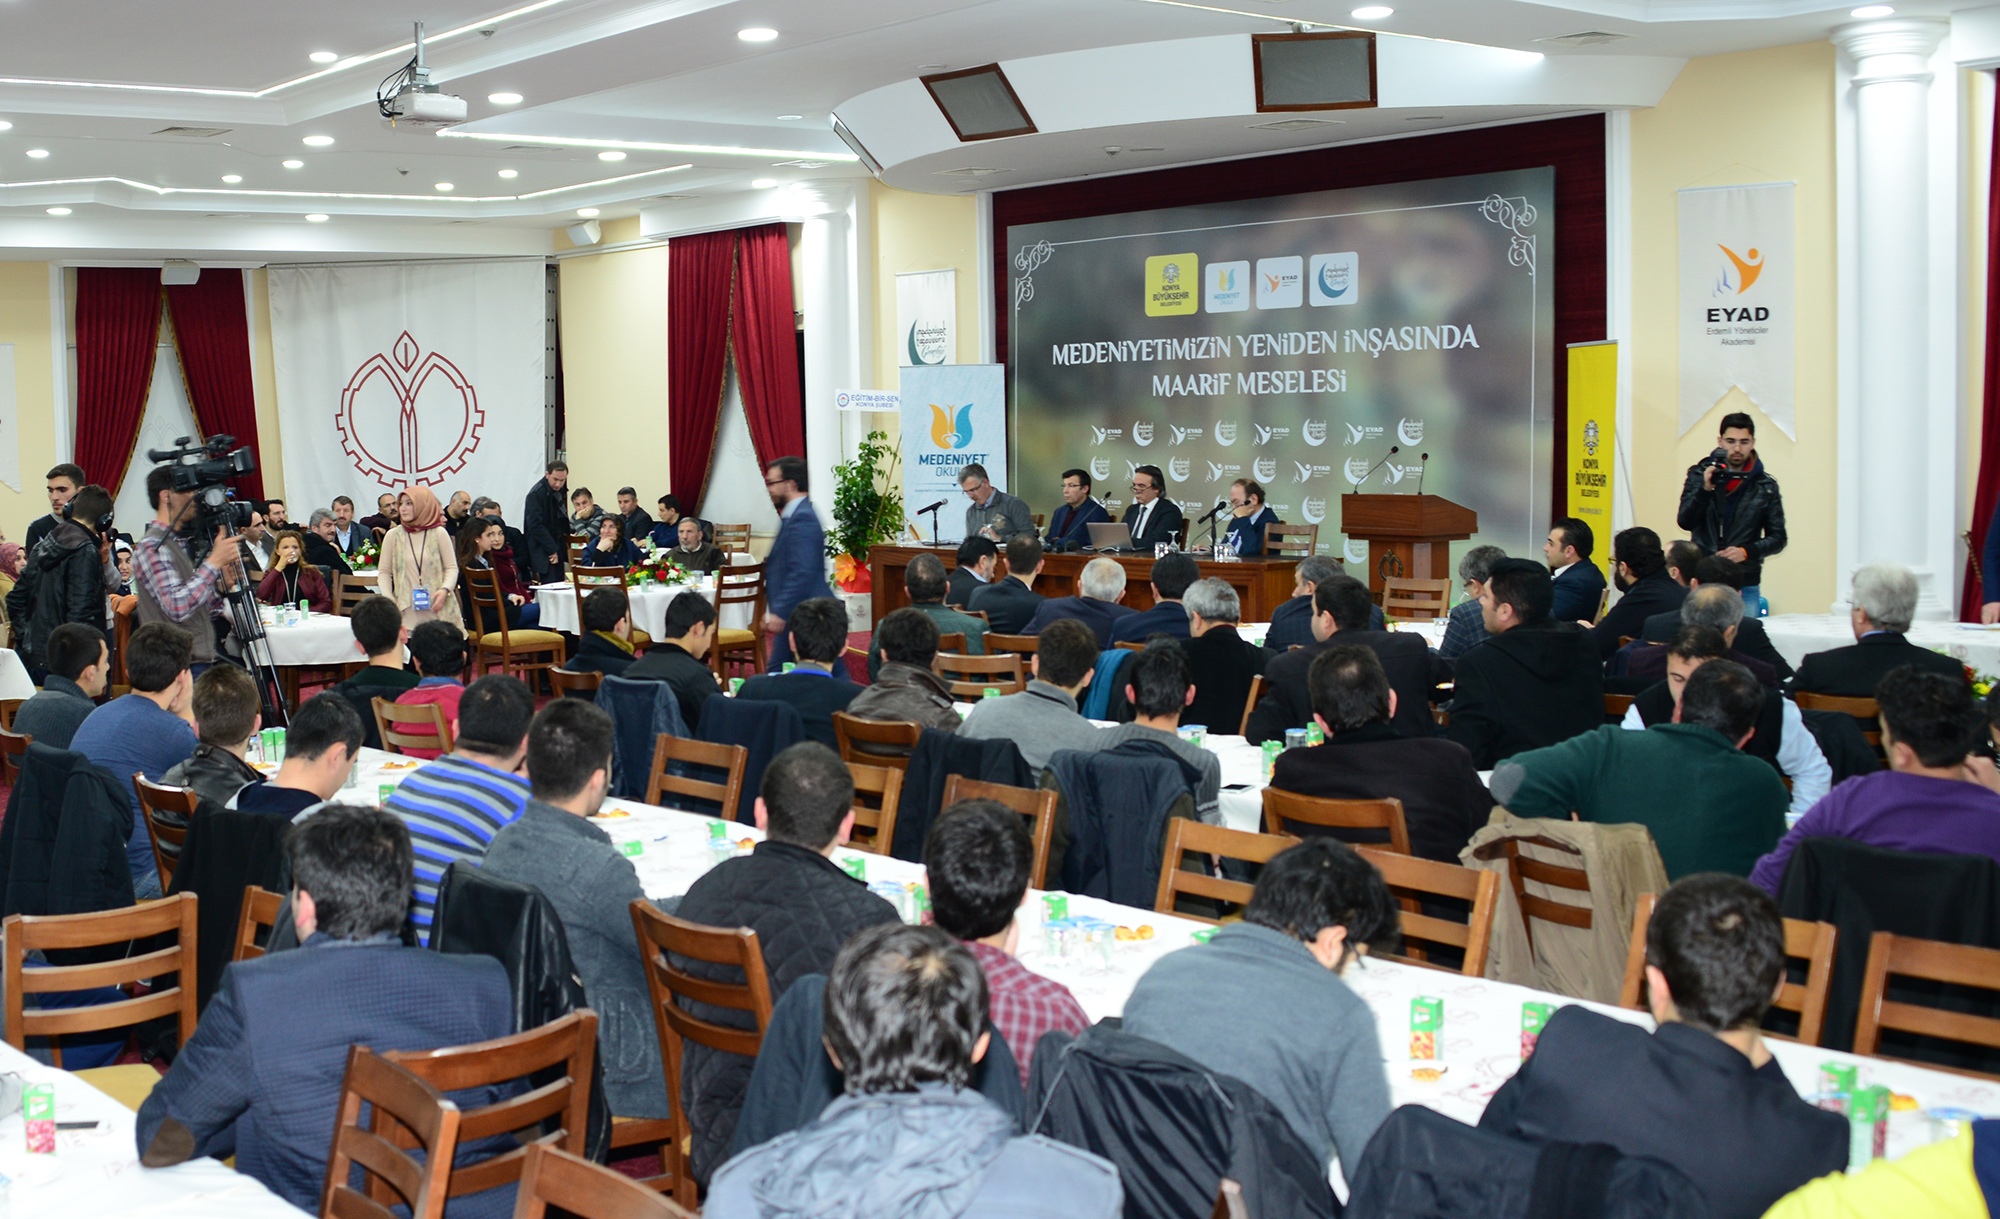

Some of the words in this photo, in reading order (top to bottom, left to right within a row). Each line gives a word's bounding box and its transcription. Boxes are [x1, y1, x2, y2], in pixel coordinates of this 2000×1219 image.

[1153, 291, 1190, 302] BÜYÜKŞEHİR
[1707, 307, 1769, 322] EYAD
[1707, 327, 1732, 335] Erdemli
[1733, 326, 1769, 335] Yöneticiler
[1721, 338, 1756, 346] Akademisi
